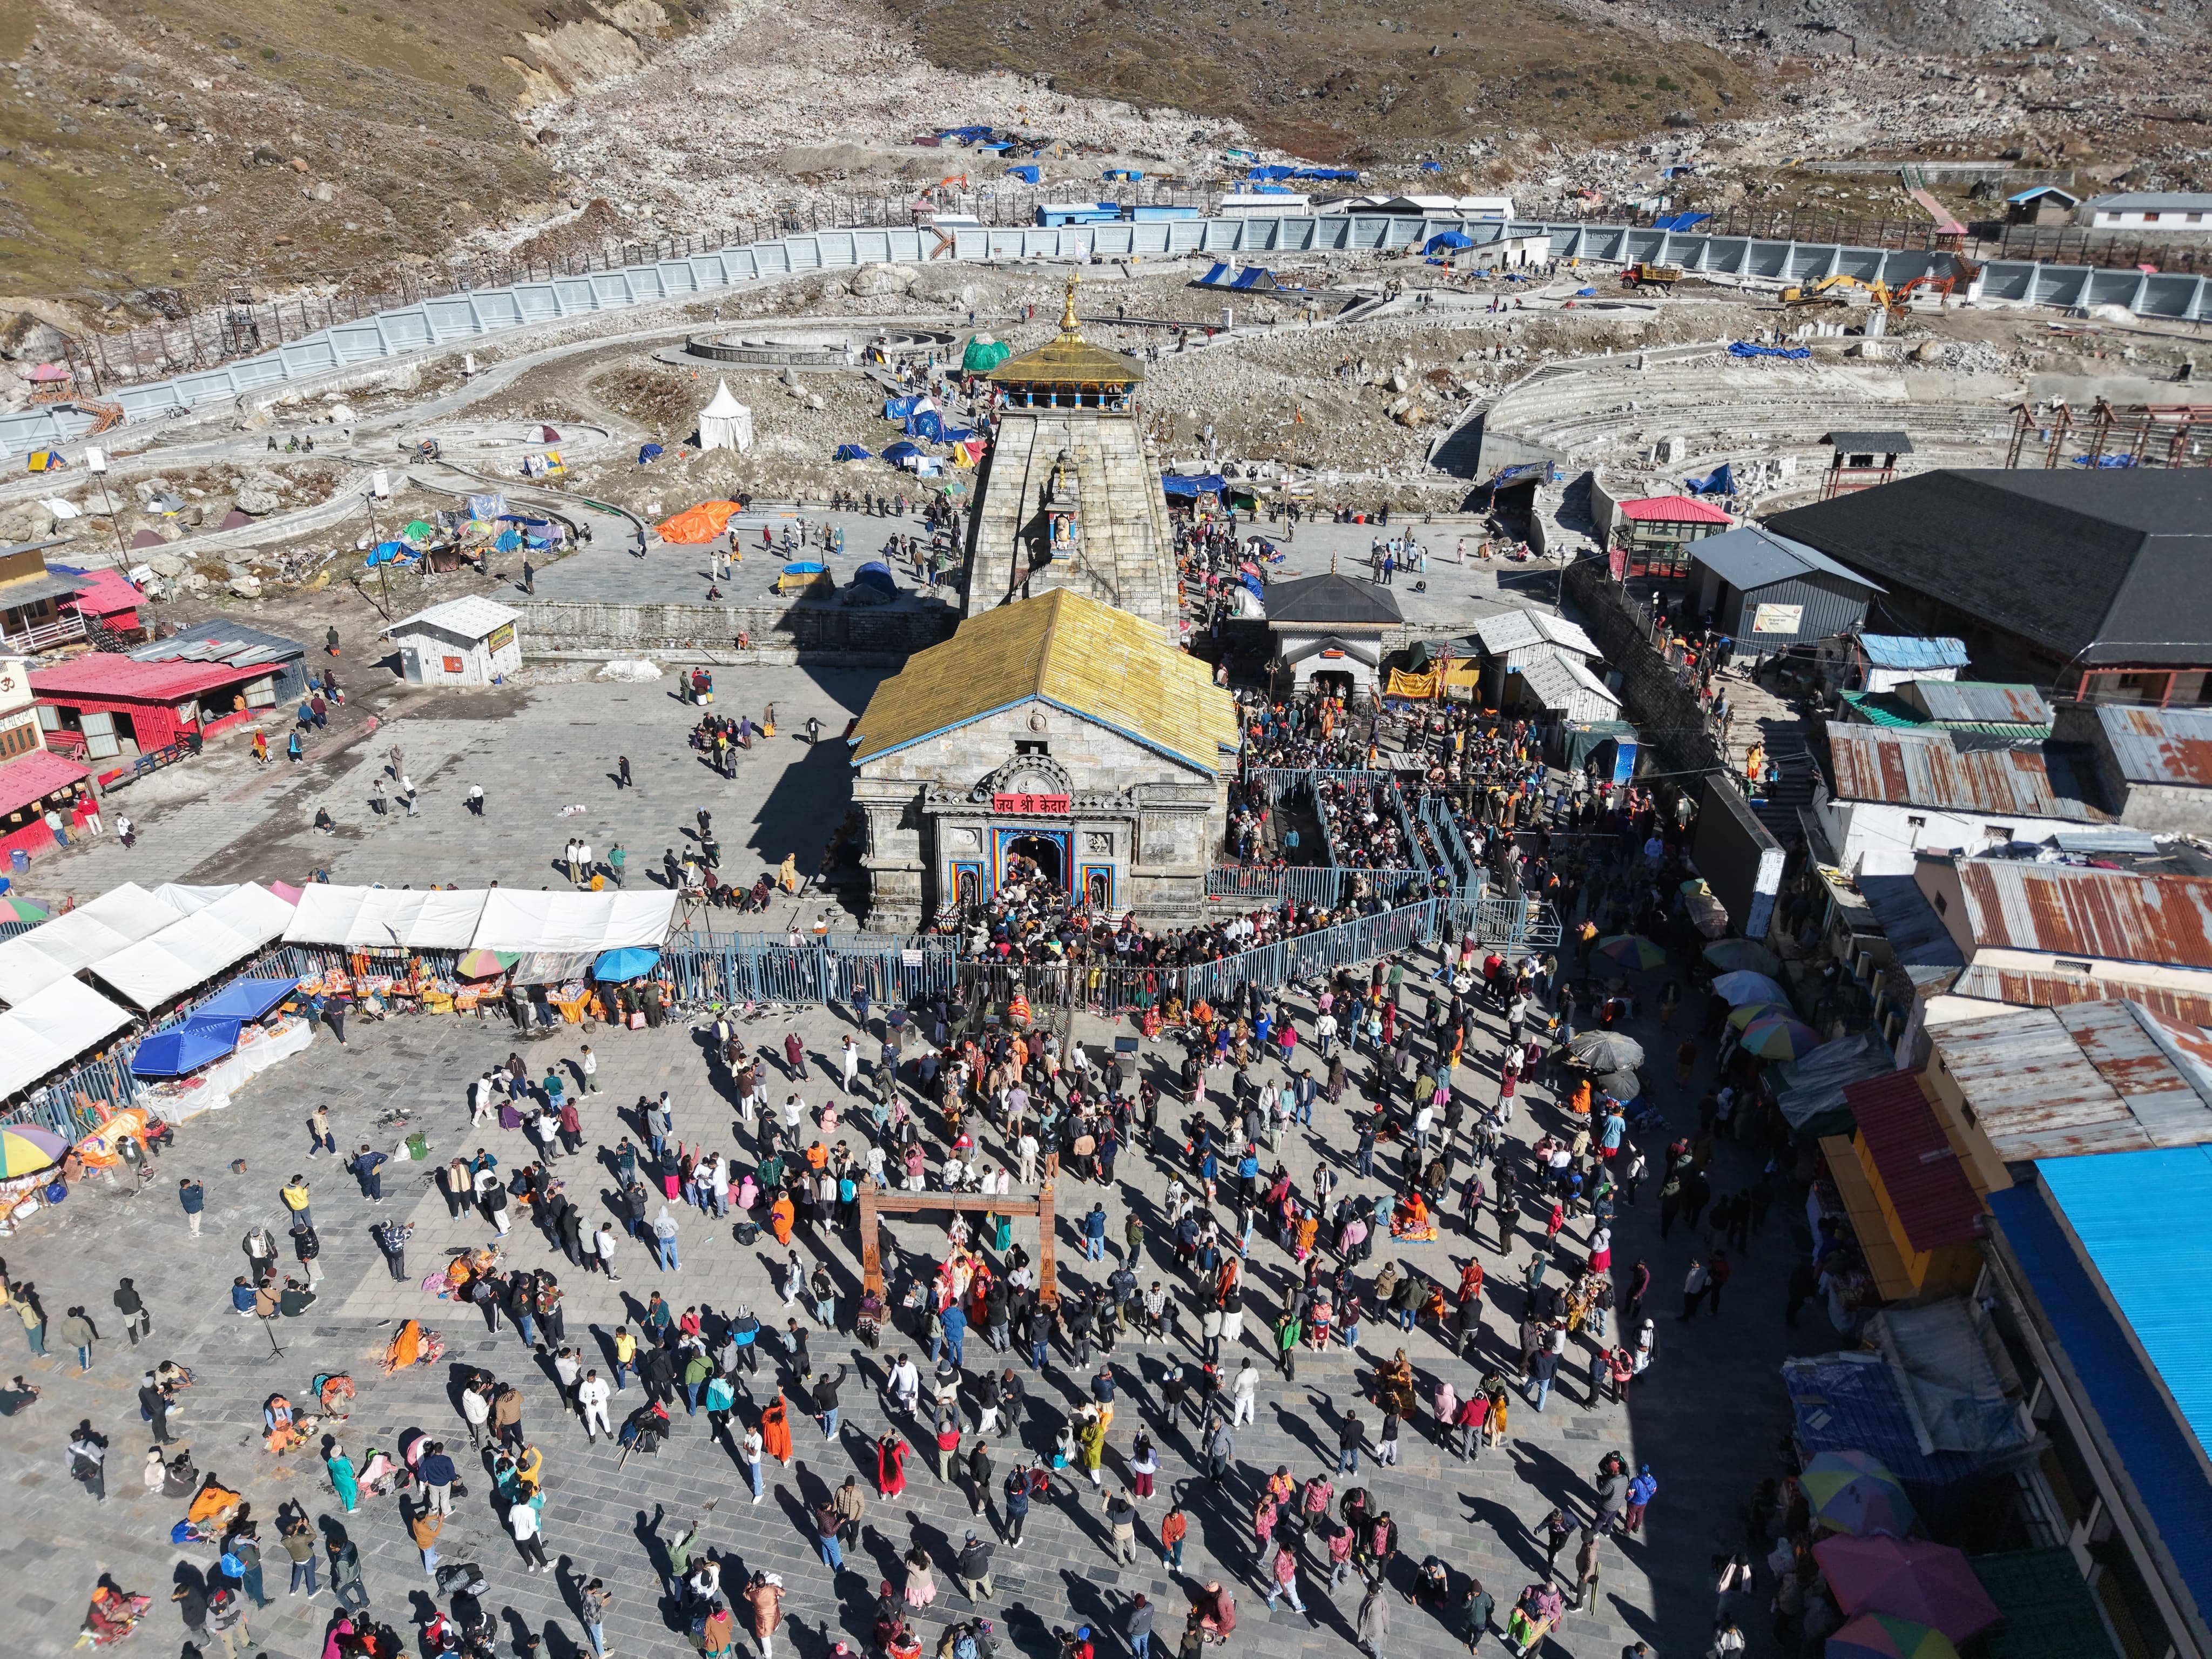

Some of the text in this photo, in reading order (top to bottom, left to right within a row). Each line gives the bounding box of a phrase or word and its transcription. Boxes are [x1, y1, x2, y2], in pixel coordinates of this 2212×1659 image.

[494, 632, 511, 644] कार्यालय
[996, 794, 1067, 813] जय श्री केदार
